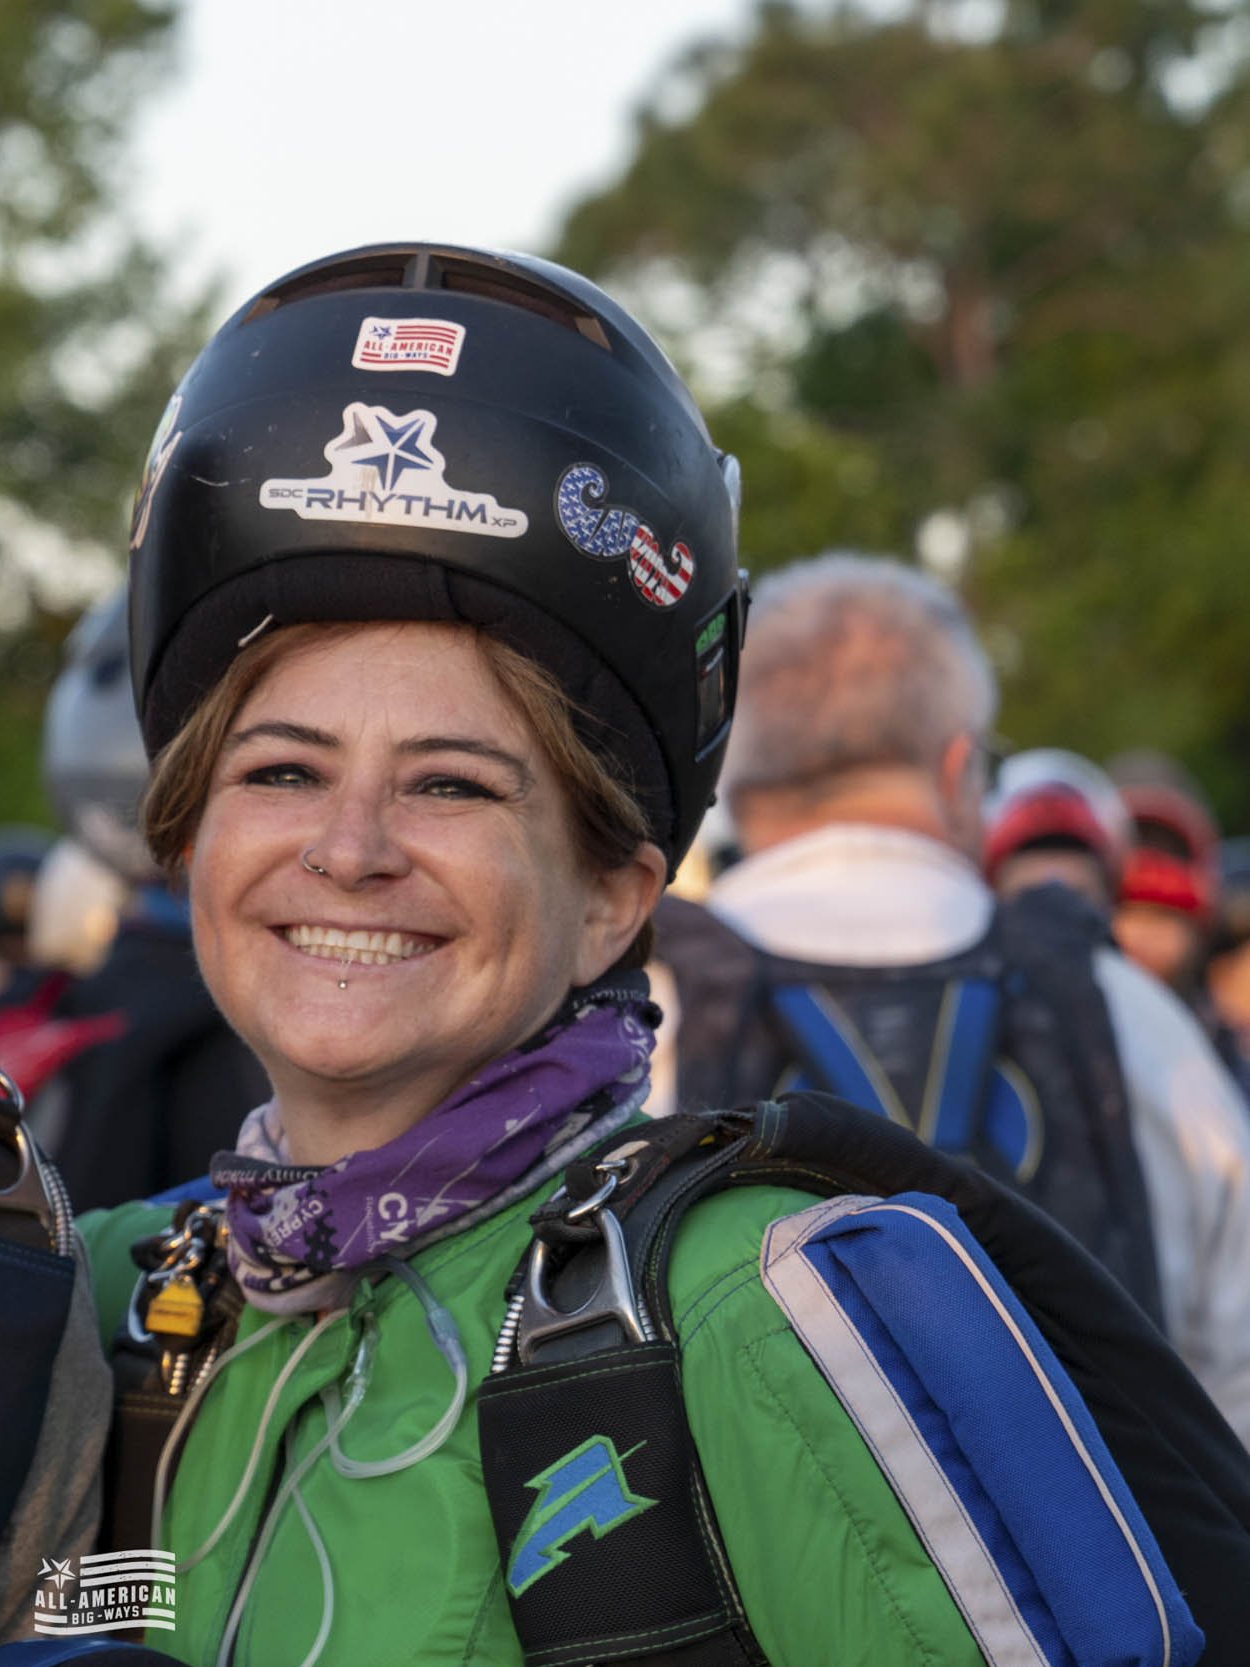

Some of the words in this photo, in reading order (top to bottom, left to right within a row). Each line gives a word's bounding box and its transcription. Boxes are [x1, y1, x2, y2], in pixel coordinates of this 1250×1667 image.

[268, 488, 303, 499] SDC
[305, 488, 488, 524] RHYTHM
[490, 516, 518, 528] XP
